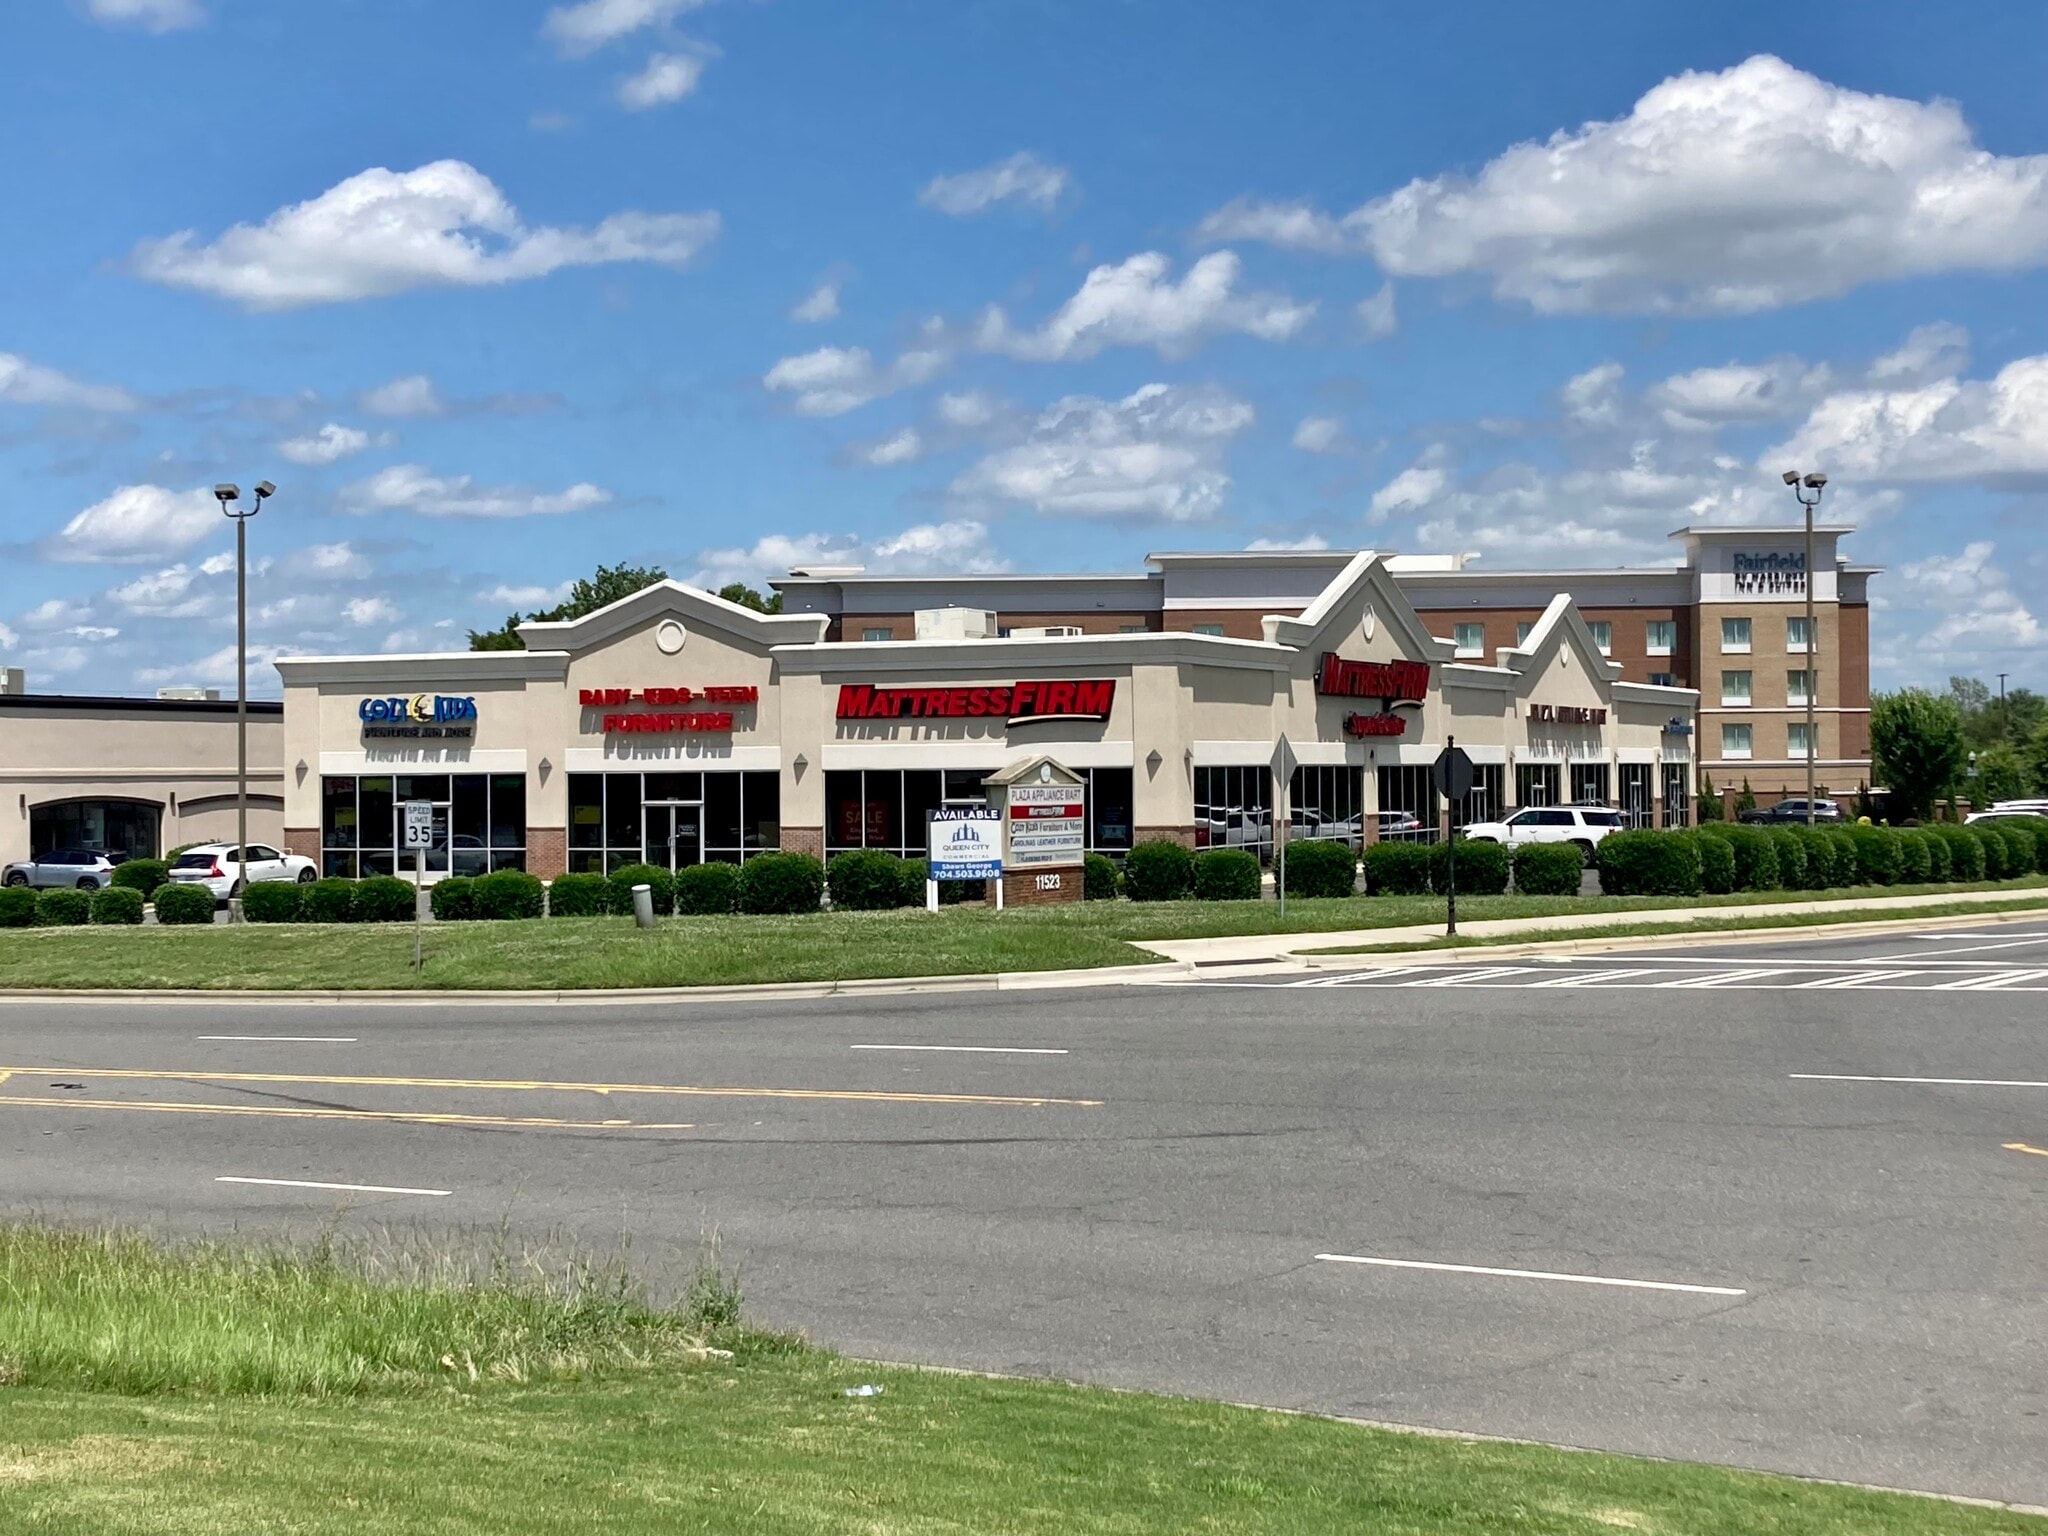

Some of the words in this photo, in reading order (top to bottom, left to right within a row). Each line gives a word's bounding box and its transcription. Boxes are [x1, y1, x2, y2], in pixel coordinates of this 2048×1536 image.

[1734, 552, 1805, 571] Fairfield
[1735, 582, 1752, 594] INN
[1769, 581, 1805, 593] SUITES
[359, 698, 409, 722] COZY
[434, 695, 477, 722] KIDS
[603, 711, 734, 733] FURNITURE
[1012, 790, 1031, 801] PLAZA
[1032, 789, 1064, 801] APPLIANCE
[1065, 789, 1081, 800] MART
[408, 806, 430, 814] SPEED
[933, 809, 999, 820] AVAILABLE
[410, 816, 429, 824] LIMIT
[846, 811, 883, 824] SALE
[1040, 822, 1063, 832] Furniture
[1070, 820, 1083, 830] More
[408, 825, 431, 843] 35
[942, 844, 970, 852] QUEEN
[971, 843, 991, 851] CITY
[966, 862, 993, 870] George
[934, 869, 1000, 879] 704.503.9608
[1035, 873, 1061, 890] 11523
